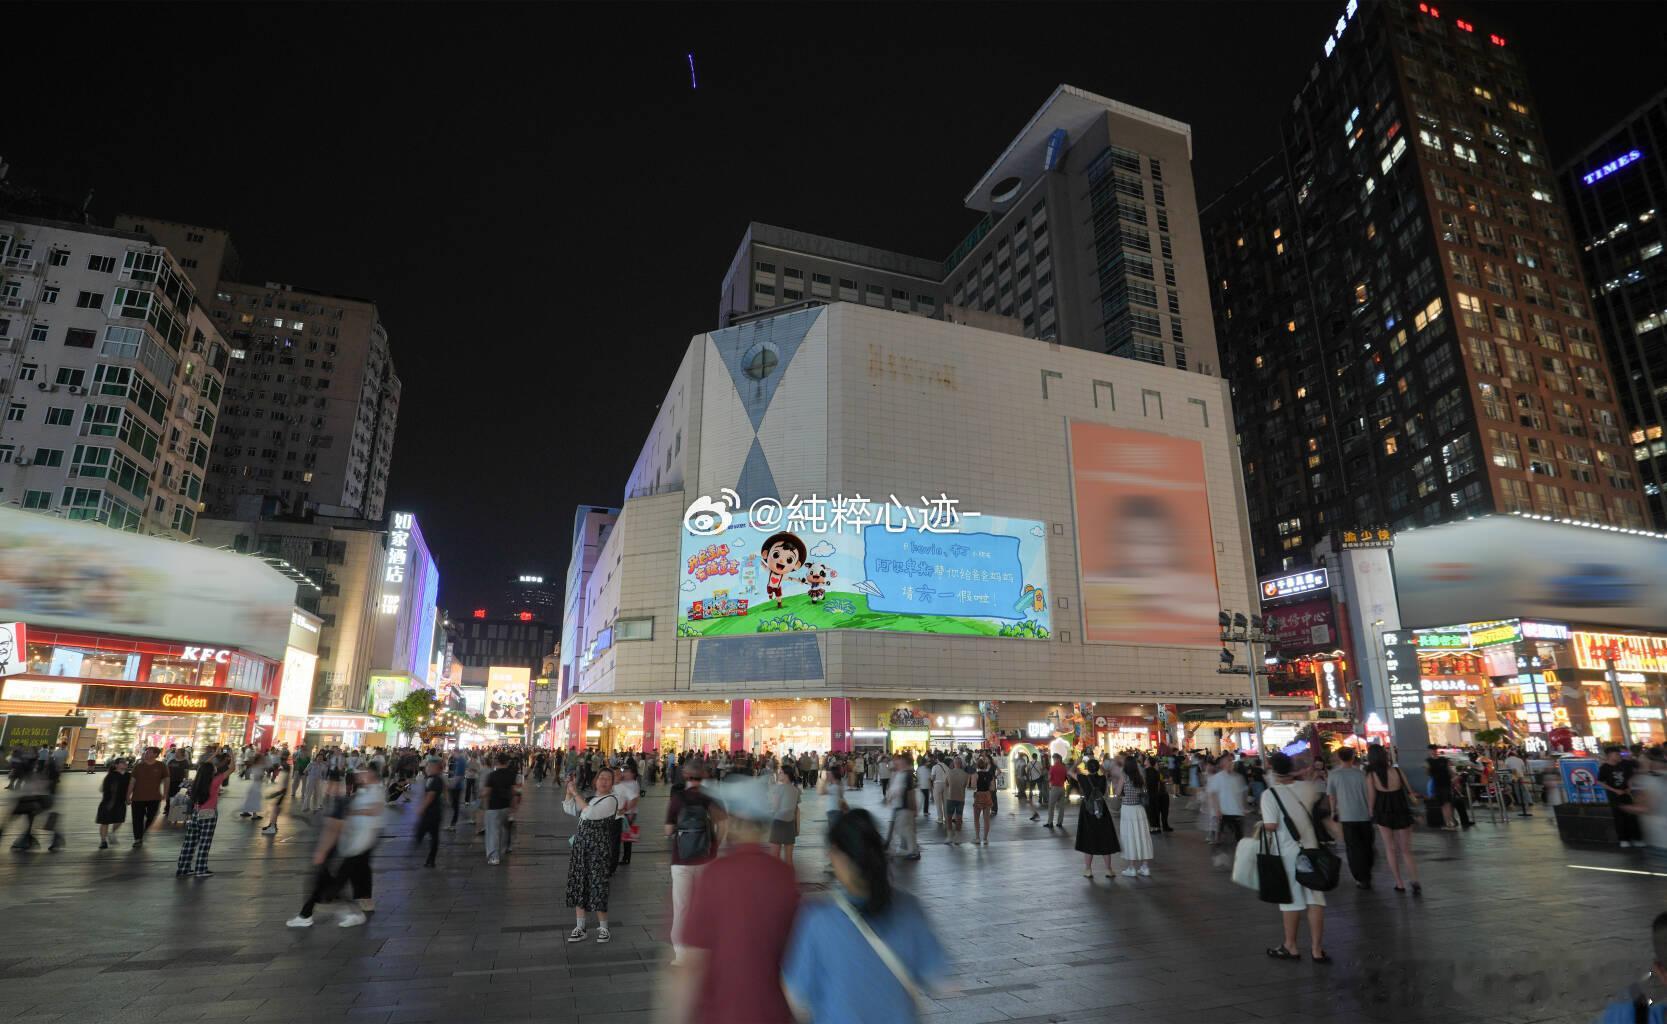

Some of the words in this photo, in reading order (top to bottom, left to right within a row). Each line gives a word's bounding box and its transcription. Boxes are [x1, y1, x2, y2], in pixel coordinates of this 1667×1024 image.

[1583, 150, 1640, 184] TIMES
[385, 513, 412, 583] 如家酒店
[181, 646, 231, 663] KFC
[162, 693, 208, 708] Cabbeen
